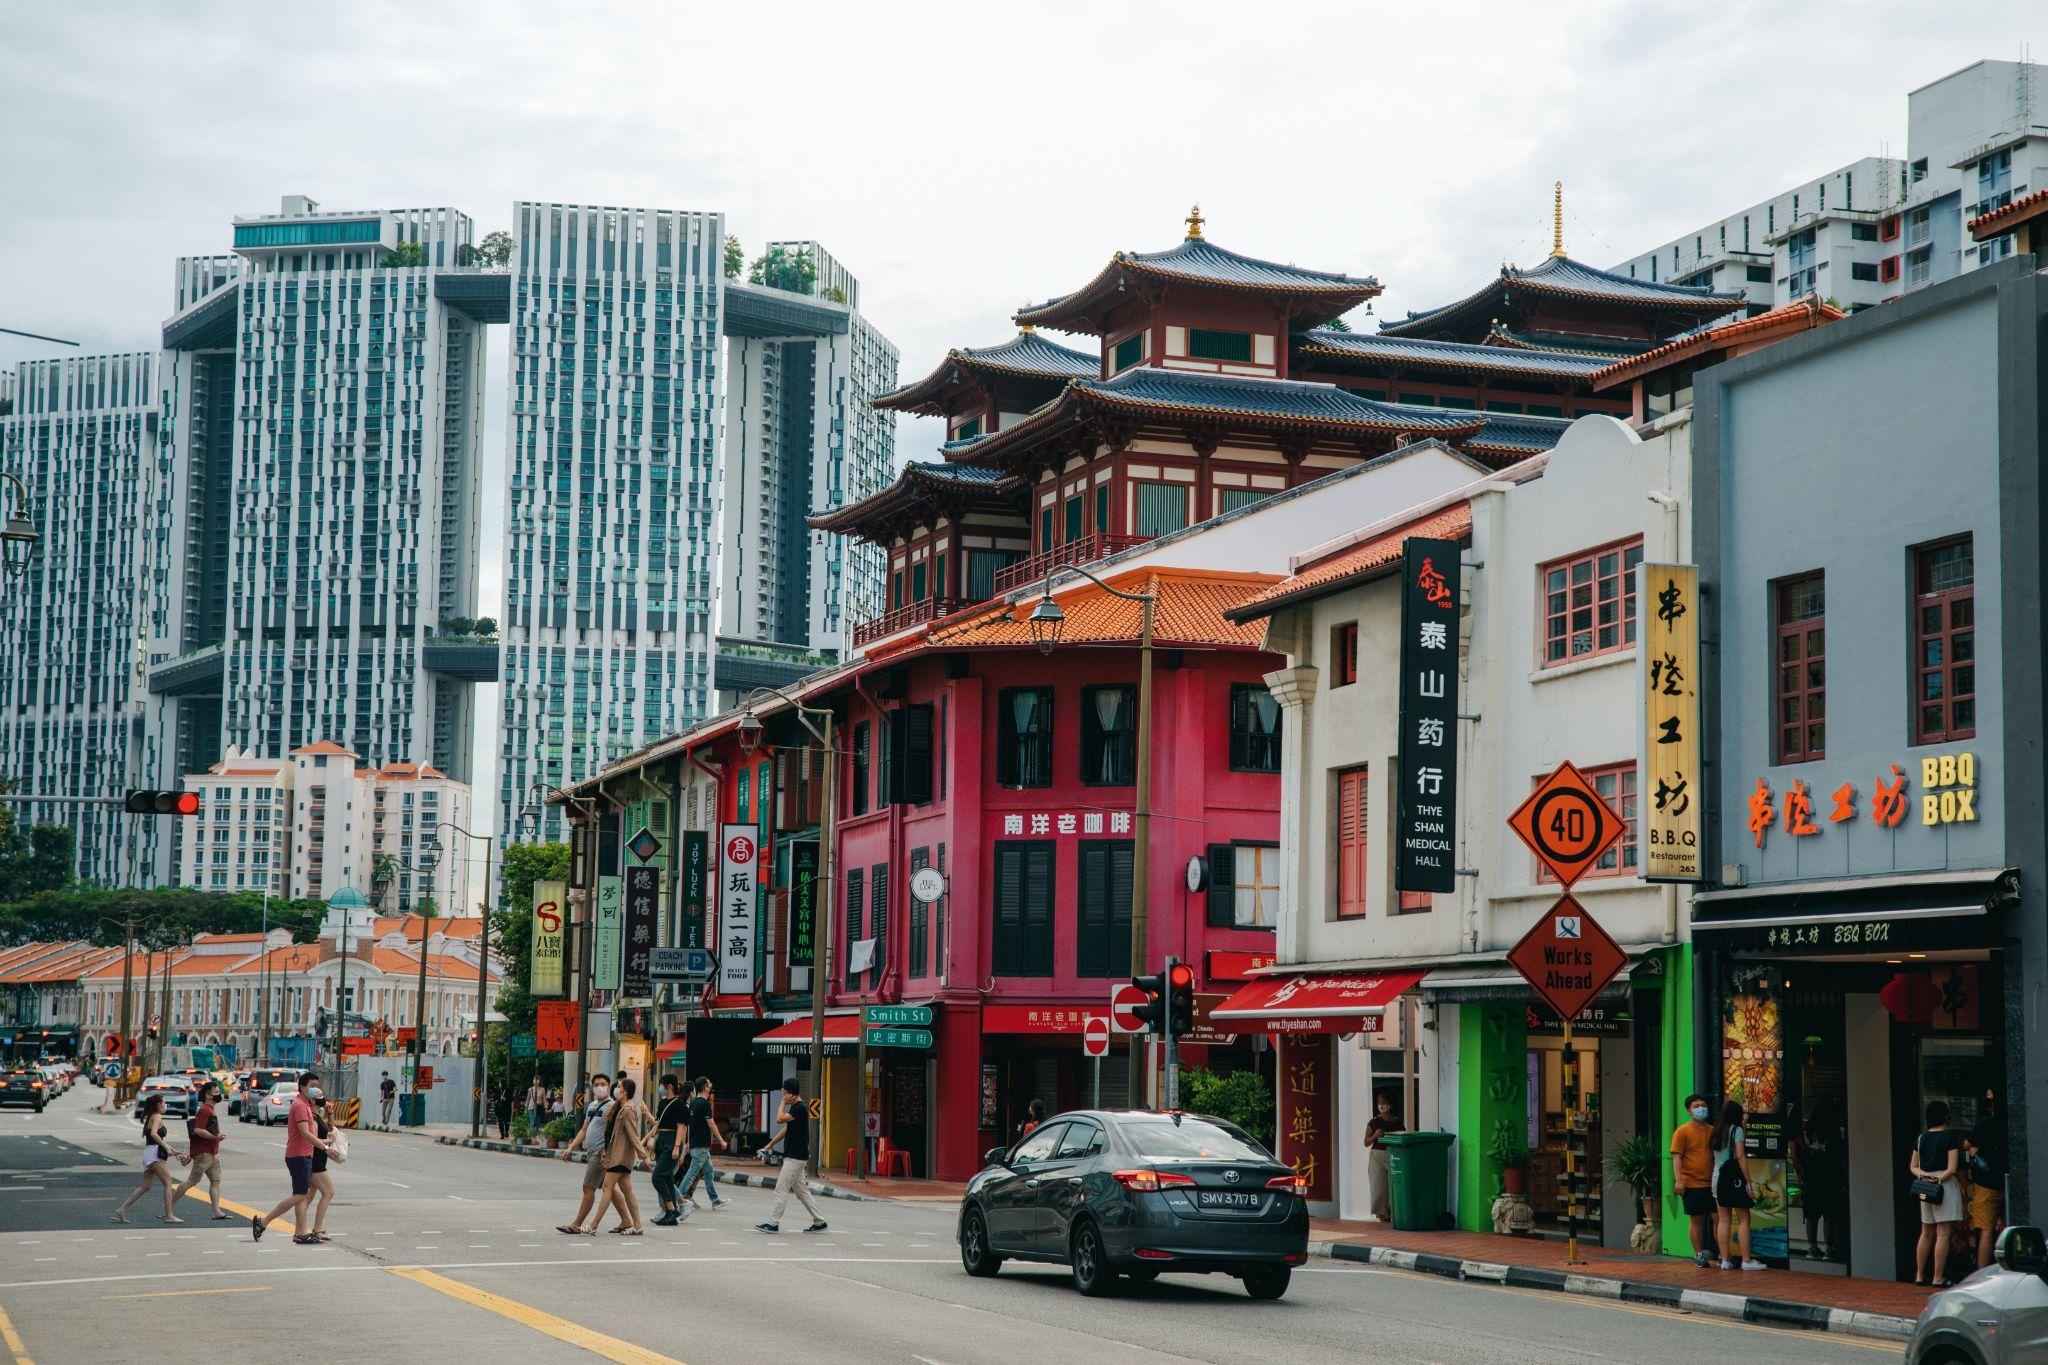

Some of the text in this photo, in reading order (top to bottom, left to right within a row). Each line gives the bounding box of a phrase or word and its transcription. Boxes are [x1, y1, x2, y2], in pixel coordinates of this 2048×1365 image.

[1417, 621, 1446, 794] 泰山药行
[1922, 752, 1974, 788] BBQ
[1417, 805, 1442, 817] THYE
[1922, 790, 1974, 825] BOX
[1005, 813, 1130, 835] 南洋老咖啡
[1414, 822, 1444, 833] SHAN
[1551, 808, 1584, 842] 40
[1406, 838, 1451, 850] MEDICAL
[1651, 829, 1696, 847] B.B.Q
[1415, 856, 1441, 867] HALL
[1651, 851, 1696, 861] Restaurant
[728, 872, 751, 958] 玩主一高
[689, 926, 697, 947] TEA
[1834, 925, 1860, 943] BBQ
[1864, 923, 1891, 941] BOX
[658, 952, 683, 960] COACH
[793, 948, 813, 959] SPA
[1544, 946, 1592, 966] Works
[655, 963, 685, 971] PARKING
[1545, 970, 1592, 990] Ahead
[870, 1009, 925, 1021] Smith St
[1558, 1009, 1604, 1020] 药行
[1267, 1017, 1377, 1032] www.thyeshan.com 266
[1560, 1021, 1577, 1029] SN
[1577, 1022, 1602, 1030] MEDICAL
[873, 1032, 926, 1044] 史密斯街
[1201, 1193, 1258, 1205] SMV 3717 B
